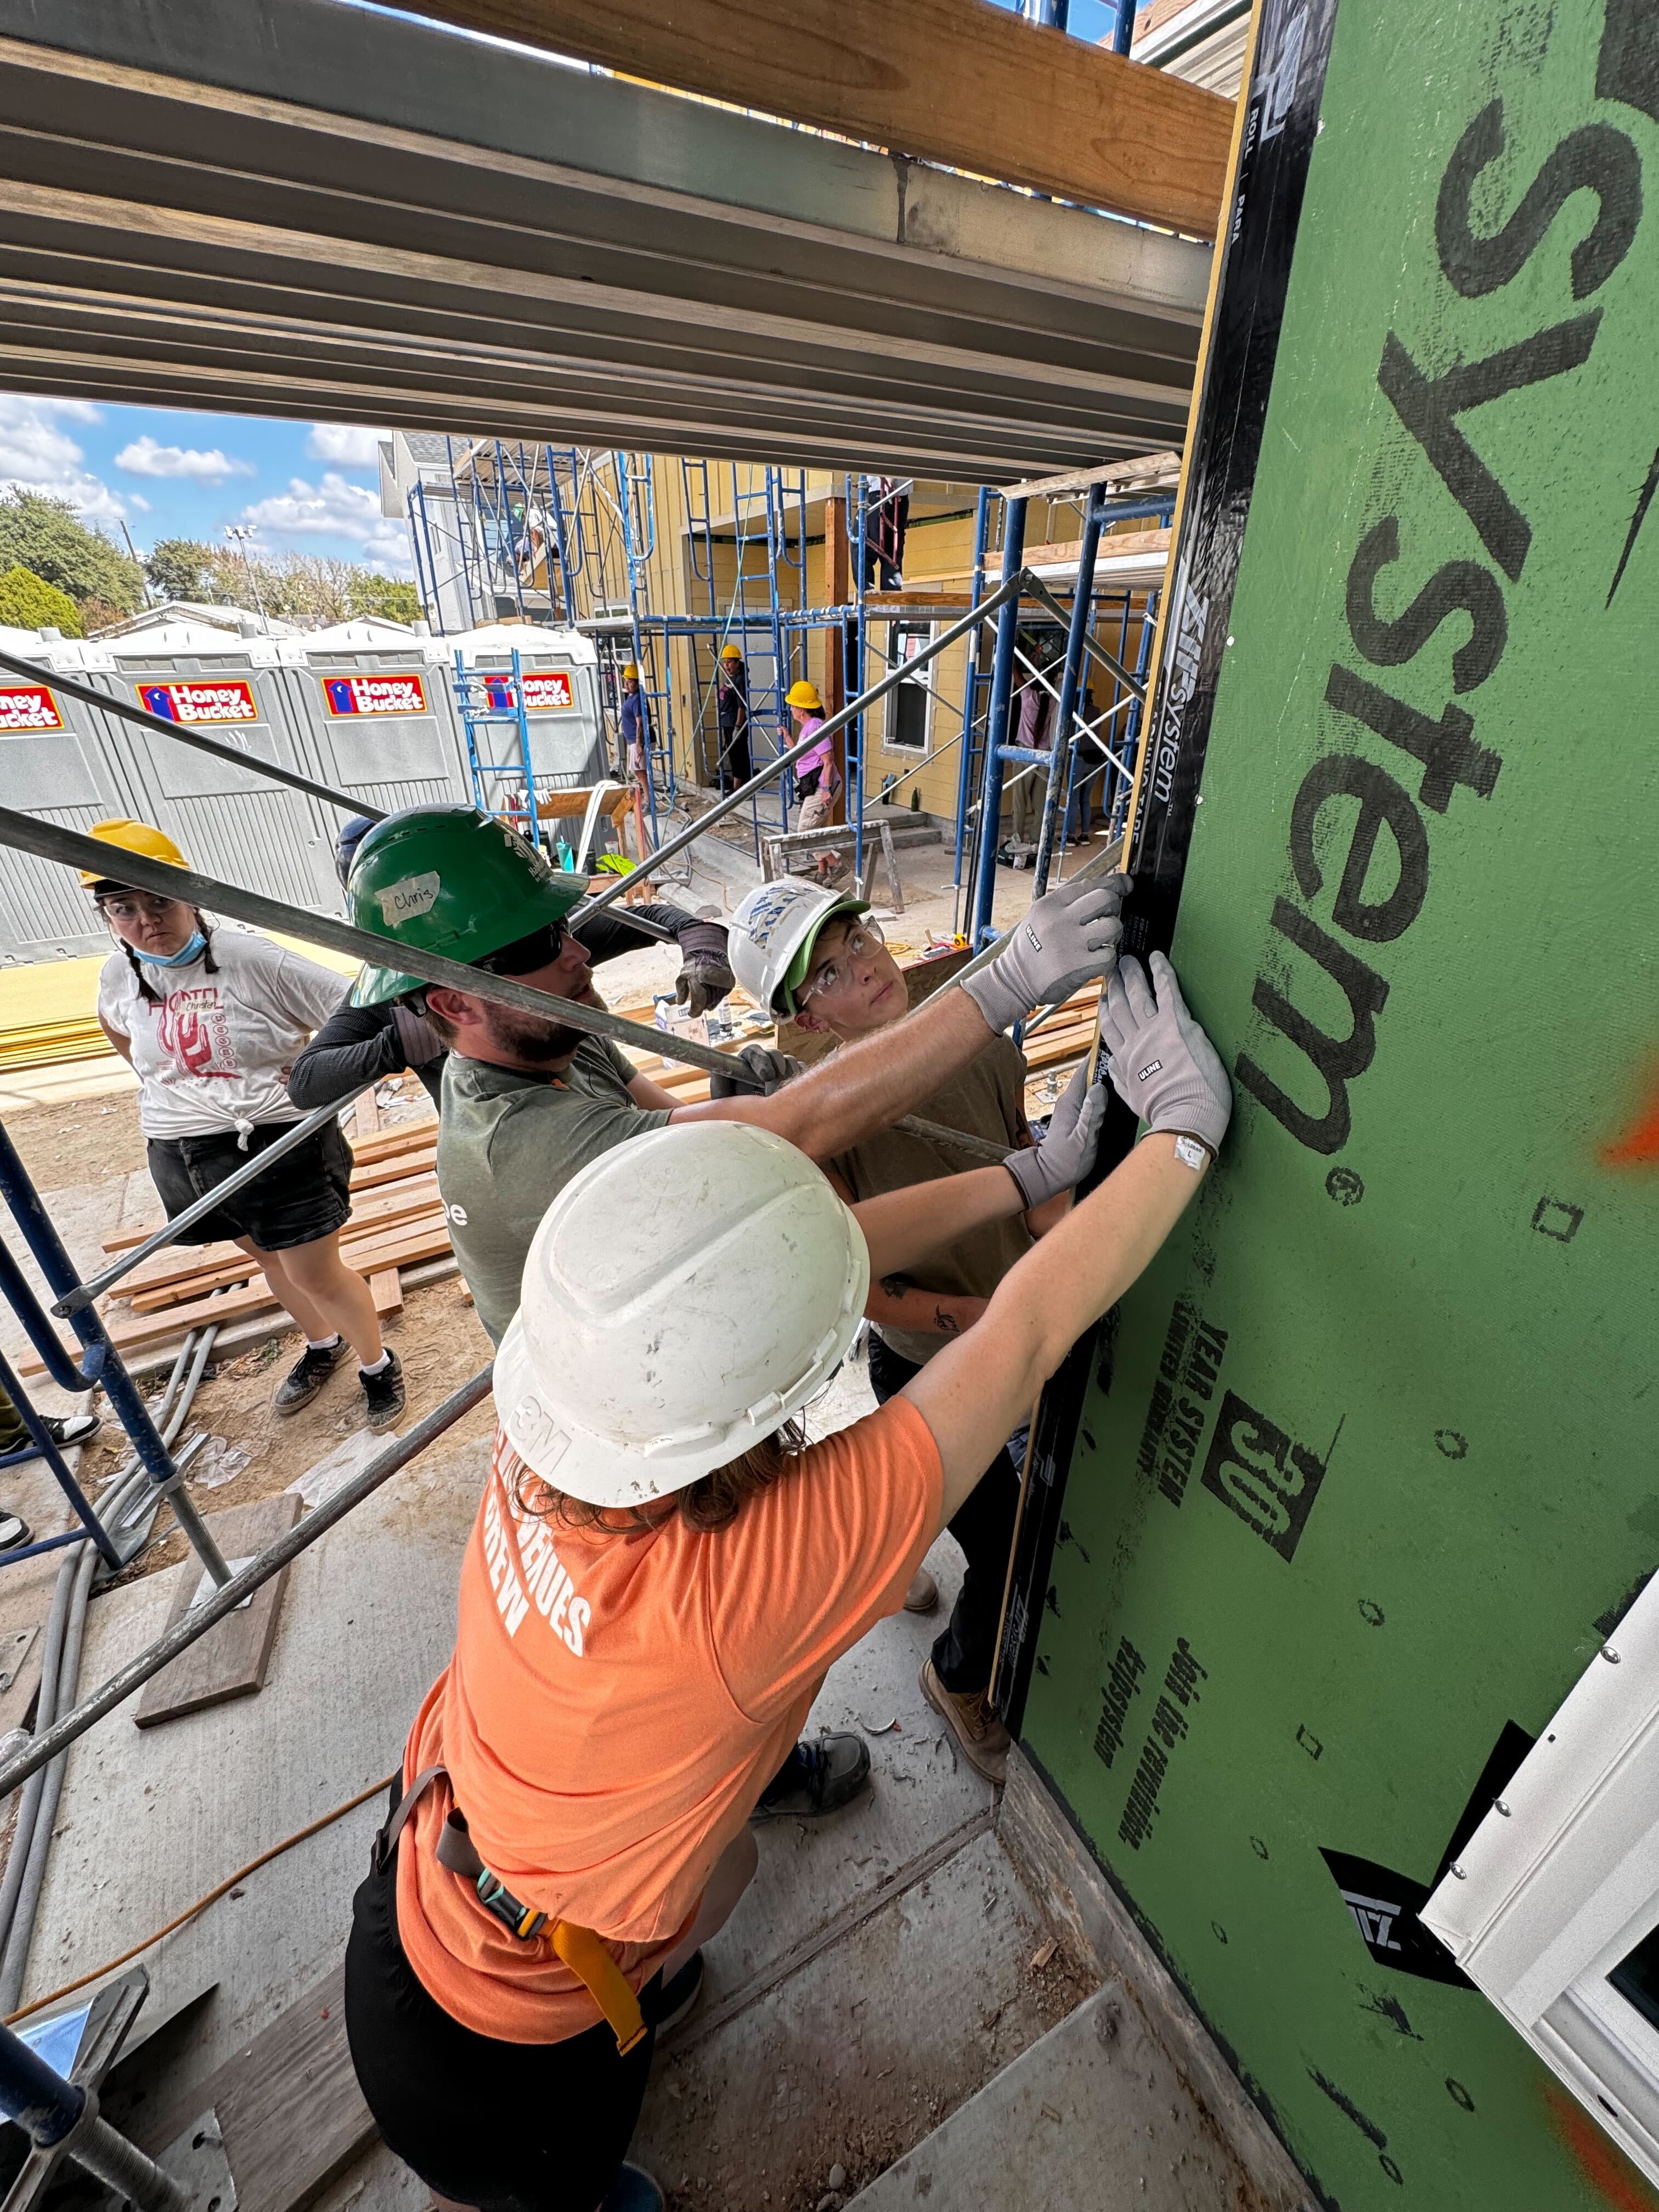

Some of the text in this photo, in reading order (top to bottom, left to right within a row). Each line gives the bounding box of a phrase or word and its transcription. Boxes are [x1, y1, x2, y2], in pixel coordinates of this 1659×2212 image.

[1232, 107, 1260, 246] ROLL PARA
[171, 685, 242, 704] Honey
[351, 679, 413, 697] Honey
[0, 695, 41, 713] ney
[176, 699, 254, 721] Bucket
[356, 693, 424, 713] Bucket
[394, 889, 434, 910] Chris
[1026, 927, 1041, 951] ULINE
[1139, 1062, 1161, 1080] ULINE
[1159, 1321, 1228, 1508] YEAR SYSTEM
[510, 1395, 573, 1476] 3M
[1220, 1419, 1306, 1534] 30
[1093, 1635, 1147, 1769] #zipsystem
[1152, 1695, 1189, 1749] the
